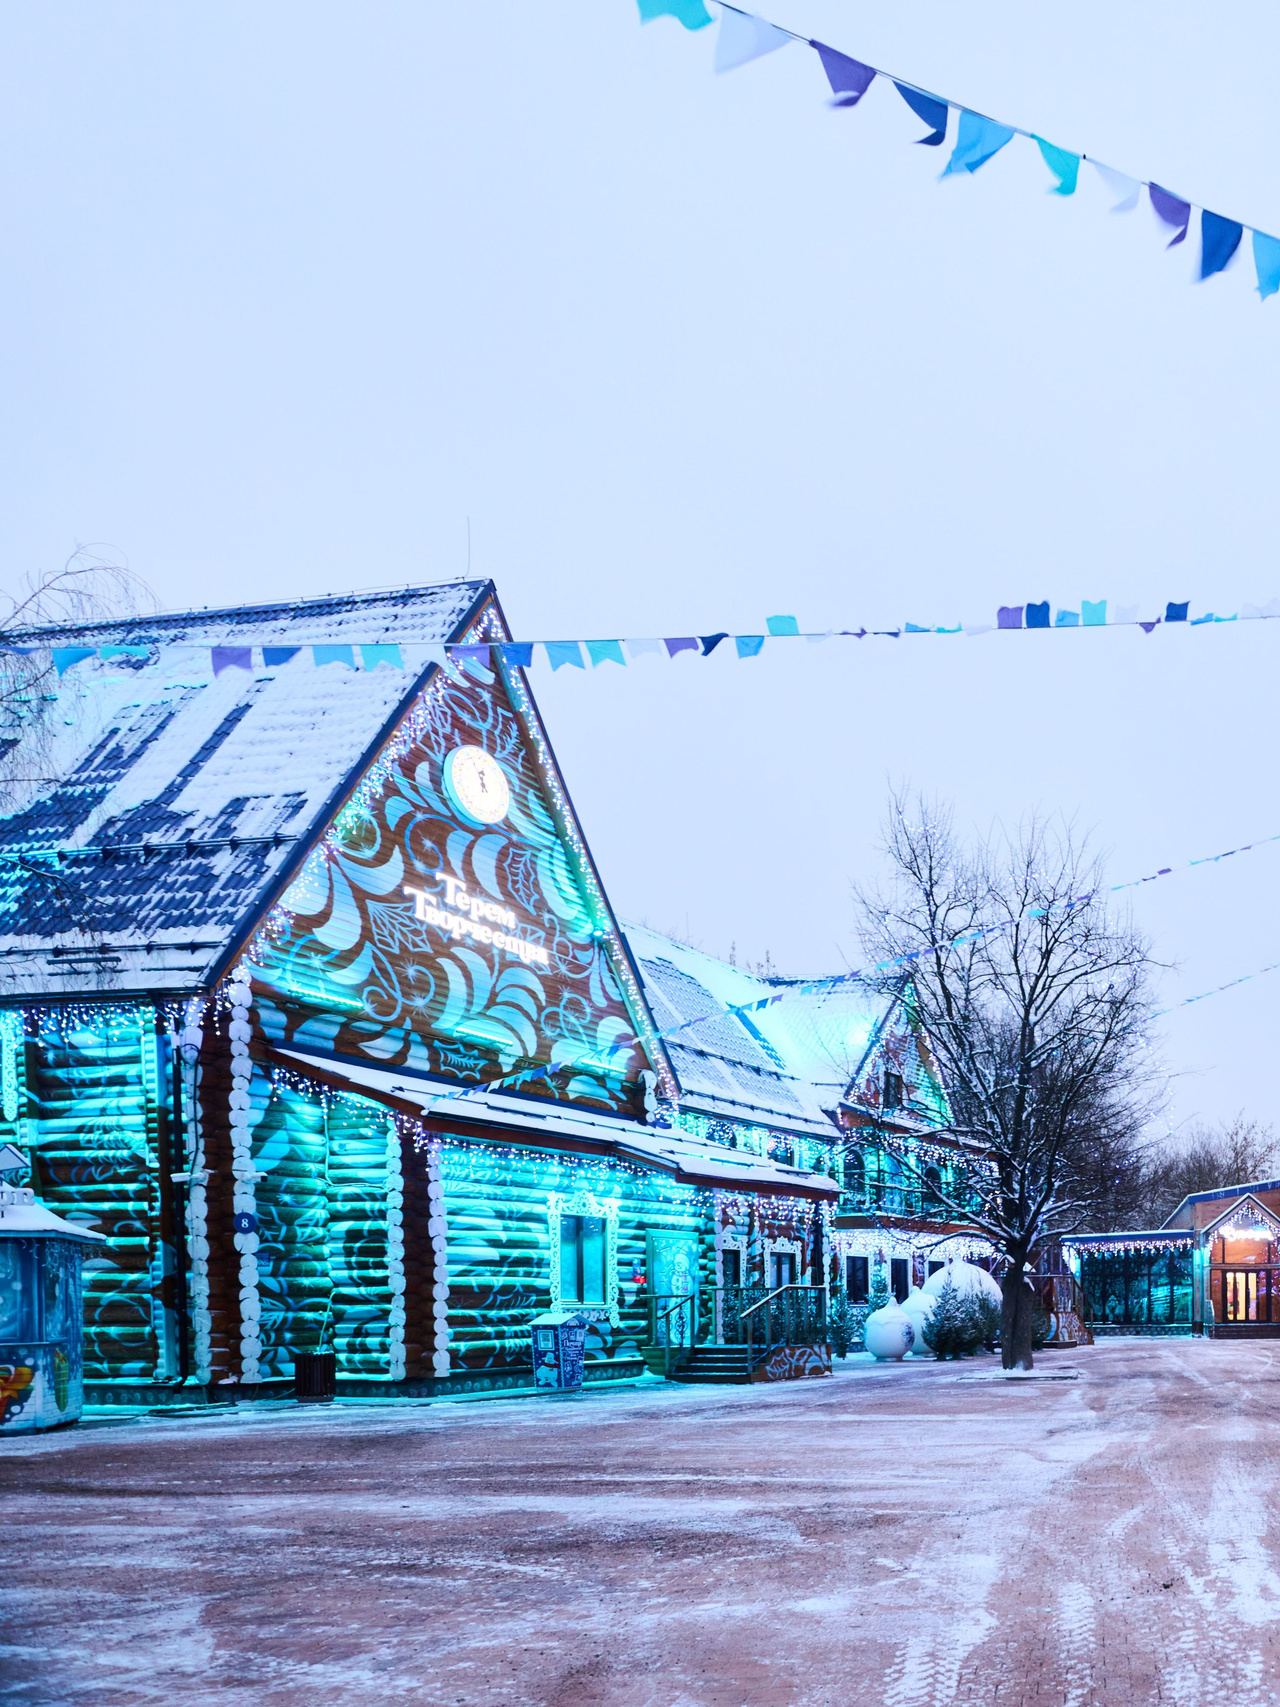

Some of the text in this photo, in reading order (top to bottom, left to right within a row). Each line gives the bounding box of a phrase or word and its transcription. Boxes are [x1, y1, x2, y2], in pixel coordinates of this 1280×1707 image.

[404, 886, 549, 965] Творчества
[435, 871, 516, 929] Терем
[241, 1218, 249, 1229] 8
